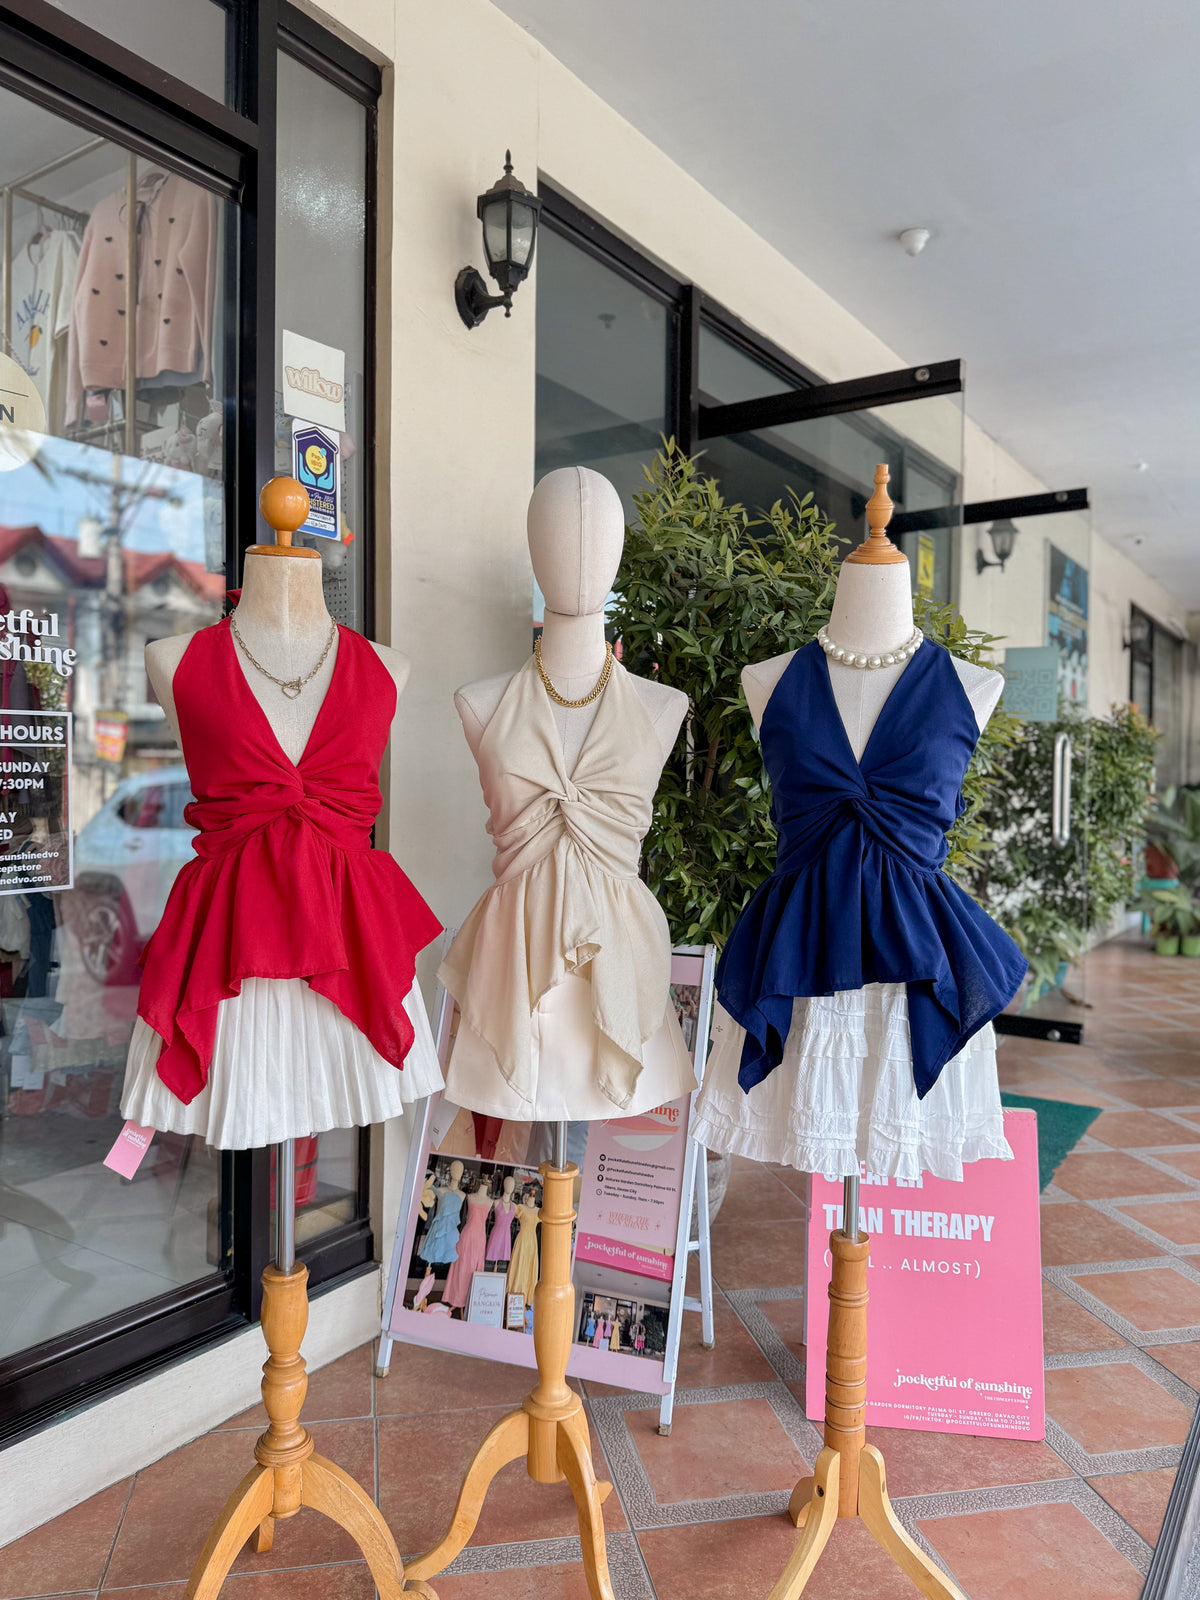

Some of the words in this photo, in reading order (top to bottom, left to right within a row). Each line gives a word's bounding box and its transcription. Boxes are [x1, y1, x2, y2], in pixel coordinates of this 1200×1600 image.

[0, 725, 64, 741] HOURS
[890, 1209, 996, 1242] THERAPY
[584, 1240, 627, 1257] pocketful
[627, 1251, 636, 1260] of
[900, 1257, 981, 1279] ALMOST)
[894, 1373, 957, 1391] pocketful
[959, 1377, 974, 1389] of
[974, 1381, 1033, 1399] sunshine
[893, 1403, 927, 1411] DORMITORY
